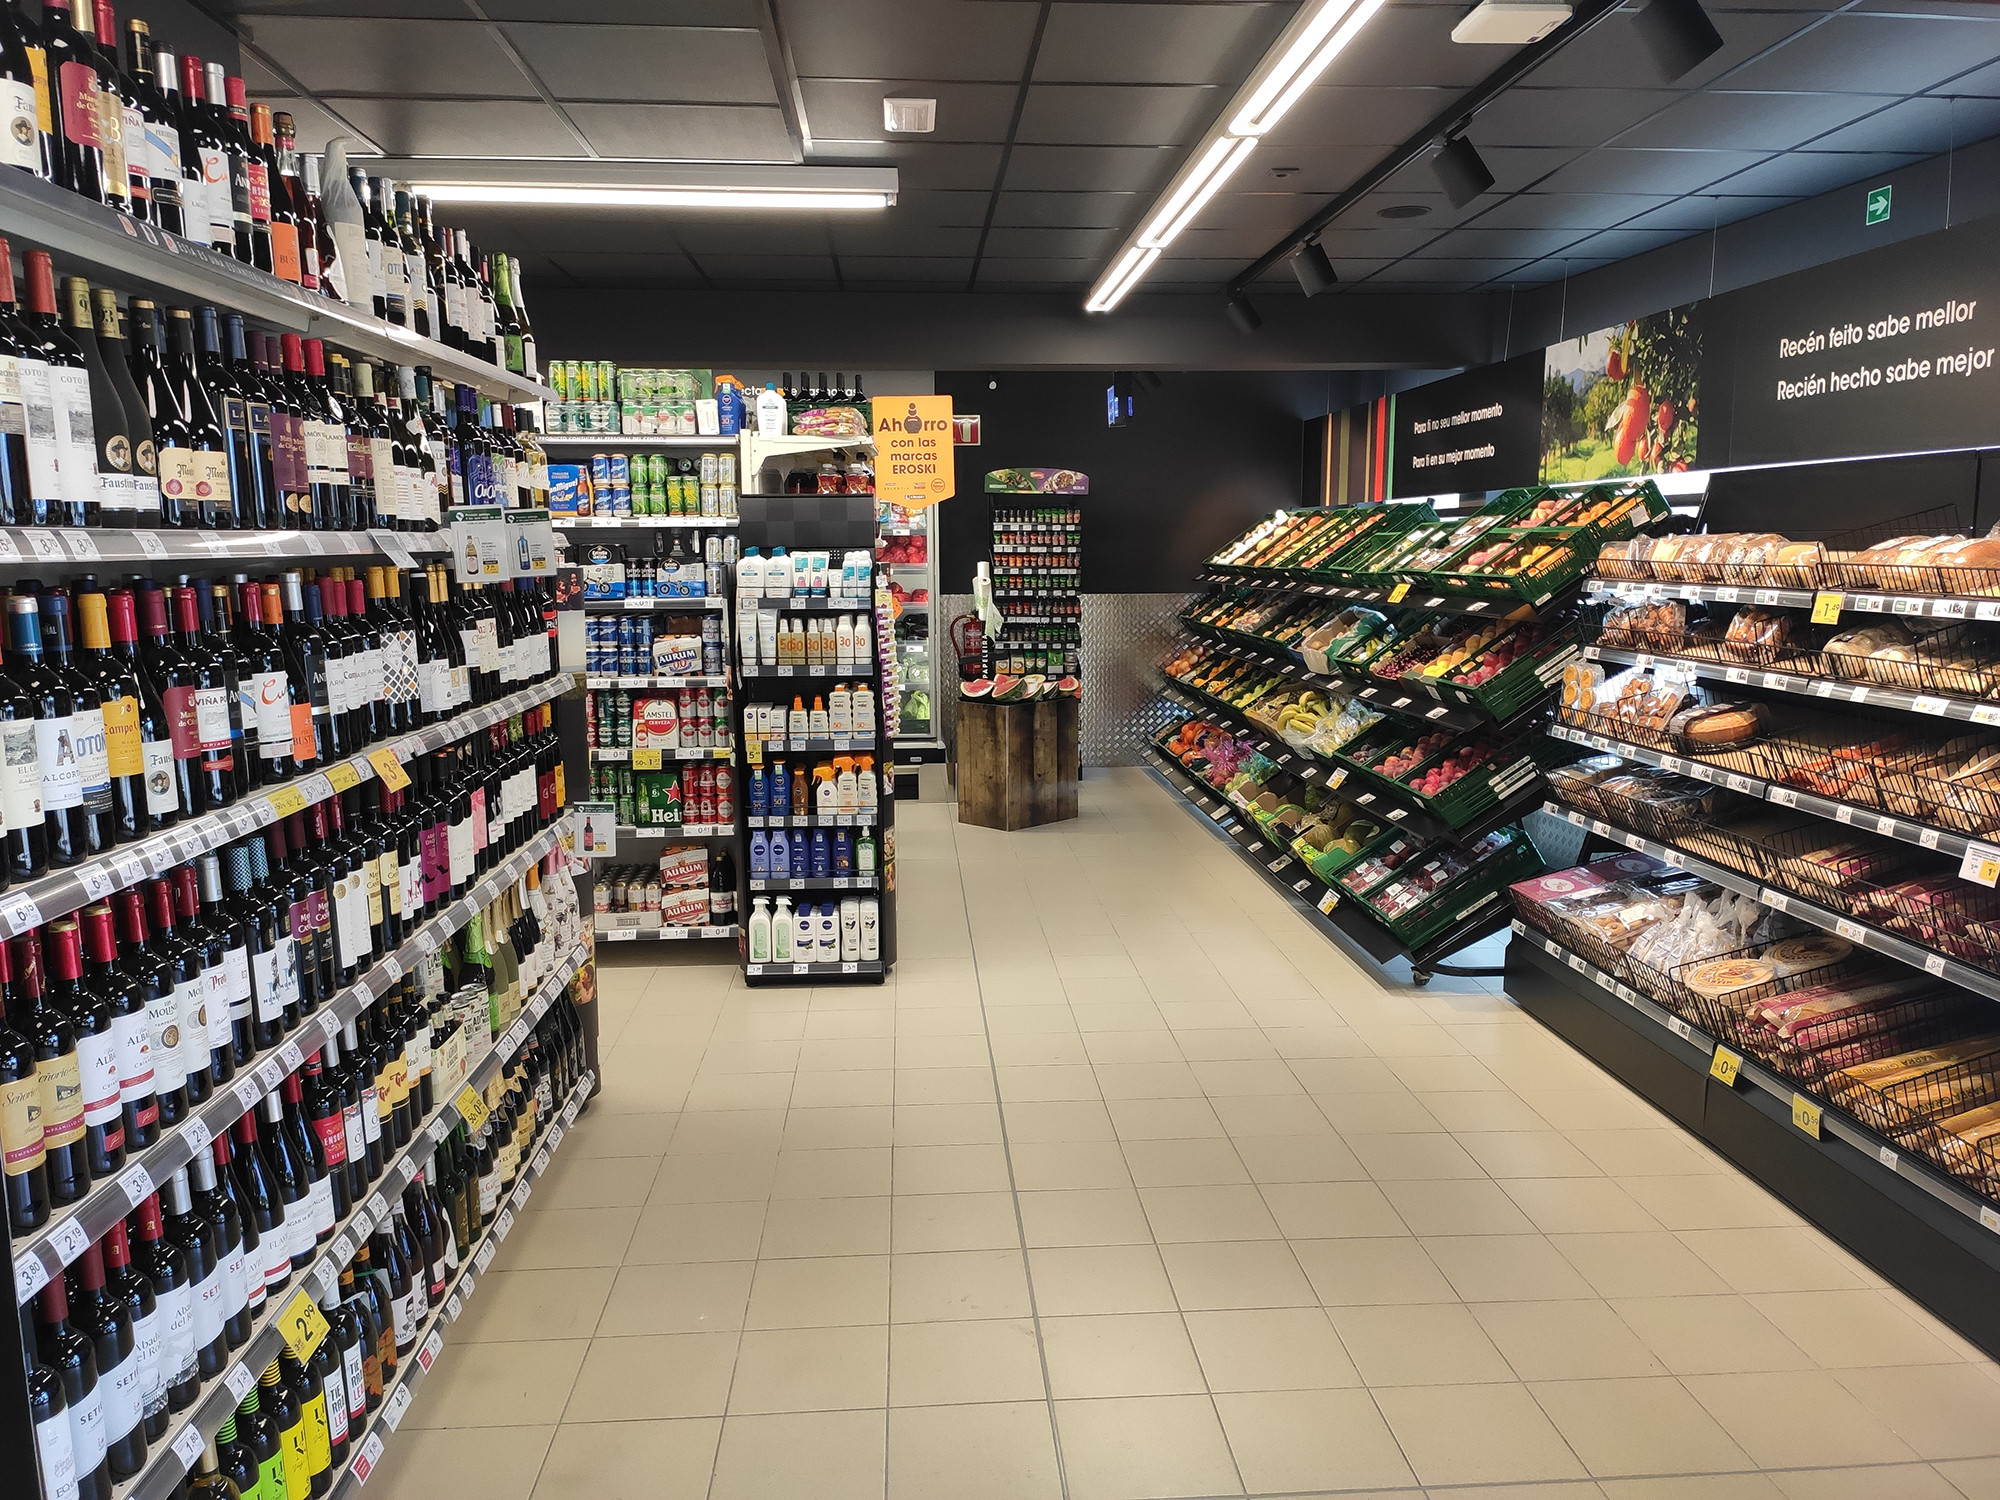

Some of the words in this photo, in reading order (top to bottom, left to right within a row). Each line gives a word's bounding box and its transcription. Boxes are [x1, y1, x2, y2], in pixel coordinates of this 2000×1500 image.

[1780, 331, 1825, 358] Recén
[1829, 323, 1863, 348] feito
[1867, 315, 1910, 340] sabe
[1916, 300, 1977, 330] mellor
[1777, 374, 1826, 400] Recién
[1830, 366, 1881, 392] hecho
[1886, 358, 1930, 383] sabe
[1936, 347, 1995, 376] mejor
[1414, 422, 1427, 434] Para
[1432, 420, 1439, 430] no
[1440, 417, 1450, 428] seu
[1451, 411, 1471, 426] mellor
[1471, 403, 1503, 422] momento
[891, 439, 914, 448] con
[918, 437, 937, 448] las
[891, 452, 938, 461] marcas
[1413, 456, 1425, 468] Para
[1430, 455, 1438, 466] en
[1438, 454, 1445, 464] su
[1446, 449, 1464, 465] mejor
[1464, 443, 1495, 460] momento
[892, 464, 936, 474] EROSKI
[823, 638, 835, 651] 30
[840, 637, 850, 648] 30
[659, 650, 698, 665] AURUM
[646, 711, 674, 719] AMSTEL
[665, 864, 703, 879] AURUM
[666, 902, 704, 917] AURUM
[132, 1172, 148, 1194] 3,05
[64, 1227, 83, 1251] 2,19
[22, 1262, 41, 1287] 3,80
[296, 1303, 316, 1343] 2,99
[185, 1432, 200, 1455] 1,80
